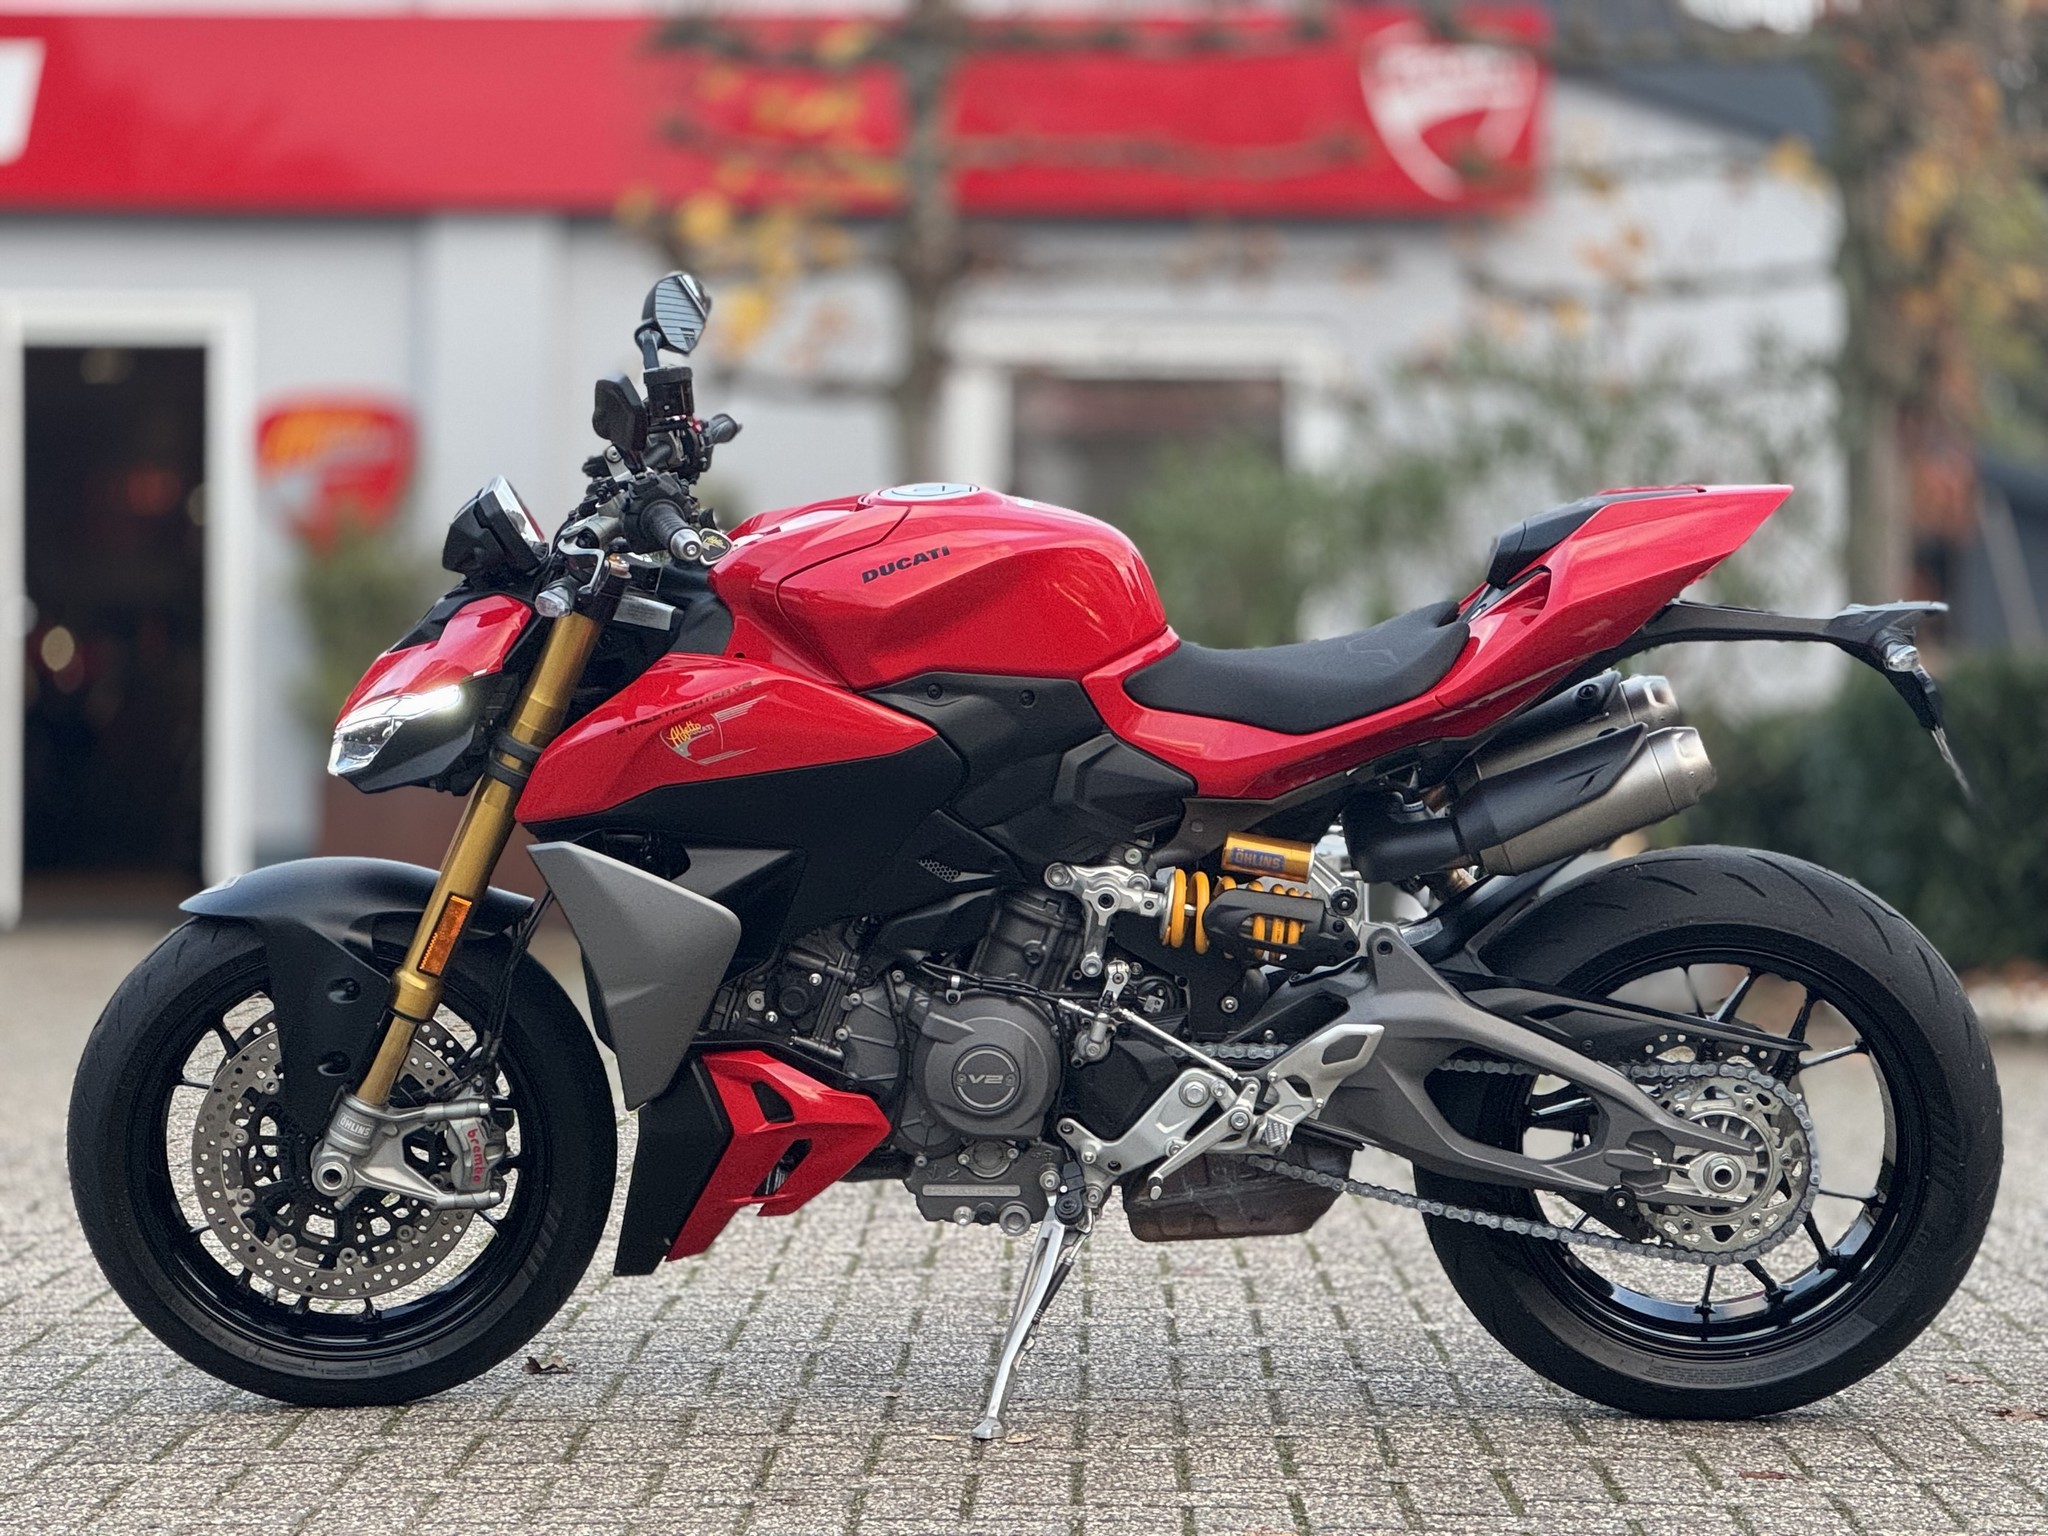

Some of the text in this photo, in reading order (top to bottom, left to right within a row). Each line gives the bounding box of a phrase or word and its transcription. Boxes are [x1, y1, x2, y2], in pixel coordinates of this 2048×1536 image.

[862, 545, 950, 584] DUCATI
[1234, 847, 1281, 870] ÖHLINS
[968, 1074, 1004, 1084] V2
[467, 1128, 486, 1184] brembo
